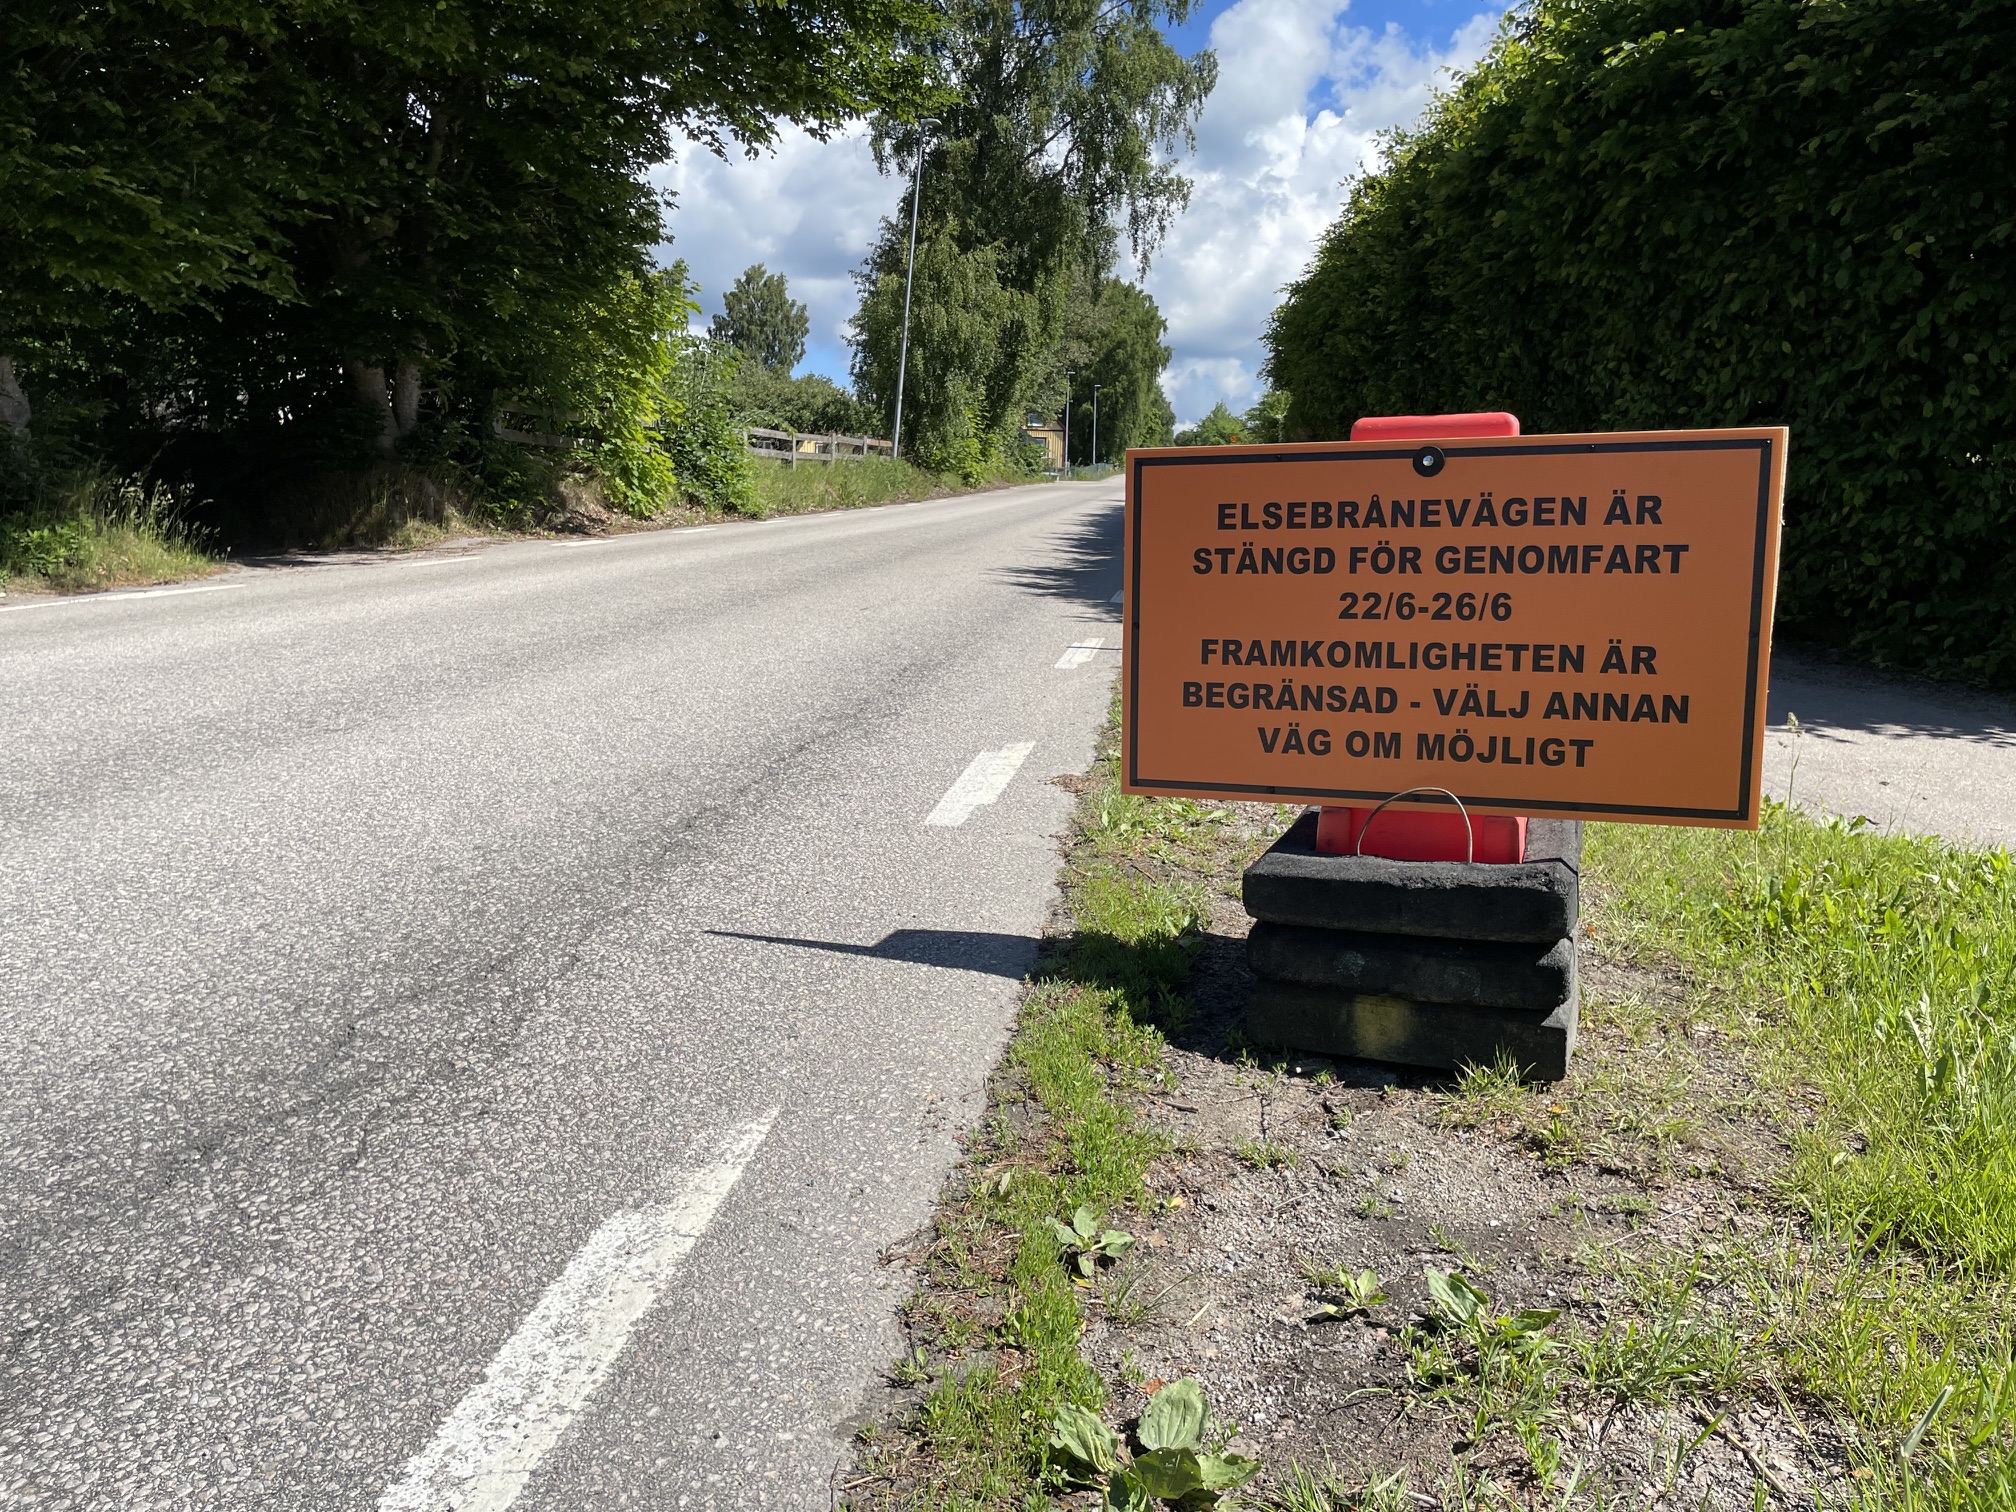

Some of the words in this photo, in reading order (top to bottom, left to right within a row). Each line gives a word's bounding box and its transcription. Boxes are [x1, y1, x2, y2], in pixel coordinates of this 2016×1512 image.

[1217, 492, 1587, 530] ELSEBRÅNEVÄGEN
[1603, 489, 1662, 525] ÄR
[1193, 542, 1335, 575] STÄNGD
[1349, 540, 1422, 574] FÖR
[1435, 544, 1689, 574] GENOMFART
[1338, 592, 1512, 621] 22/6-26/6
[1201, 639, 1584, 673] FRAMKOMLIGHETEN
[1600, 639, 1657, 675] ÄR
[1183, 678, 1398, 714] BEGRÄNSAD
[1433, 683, 1529, 718] VÄLJ
[1543, 692, 1689, 724] ANNAN
[1257, 722, 1331, 756] VÄG
[1346, 731, 1401, 759] OM
[1417, 729, 1594, 767] MÖJLIGT
